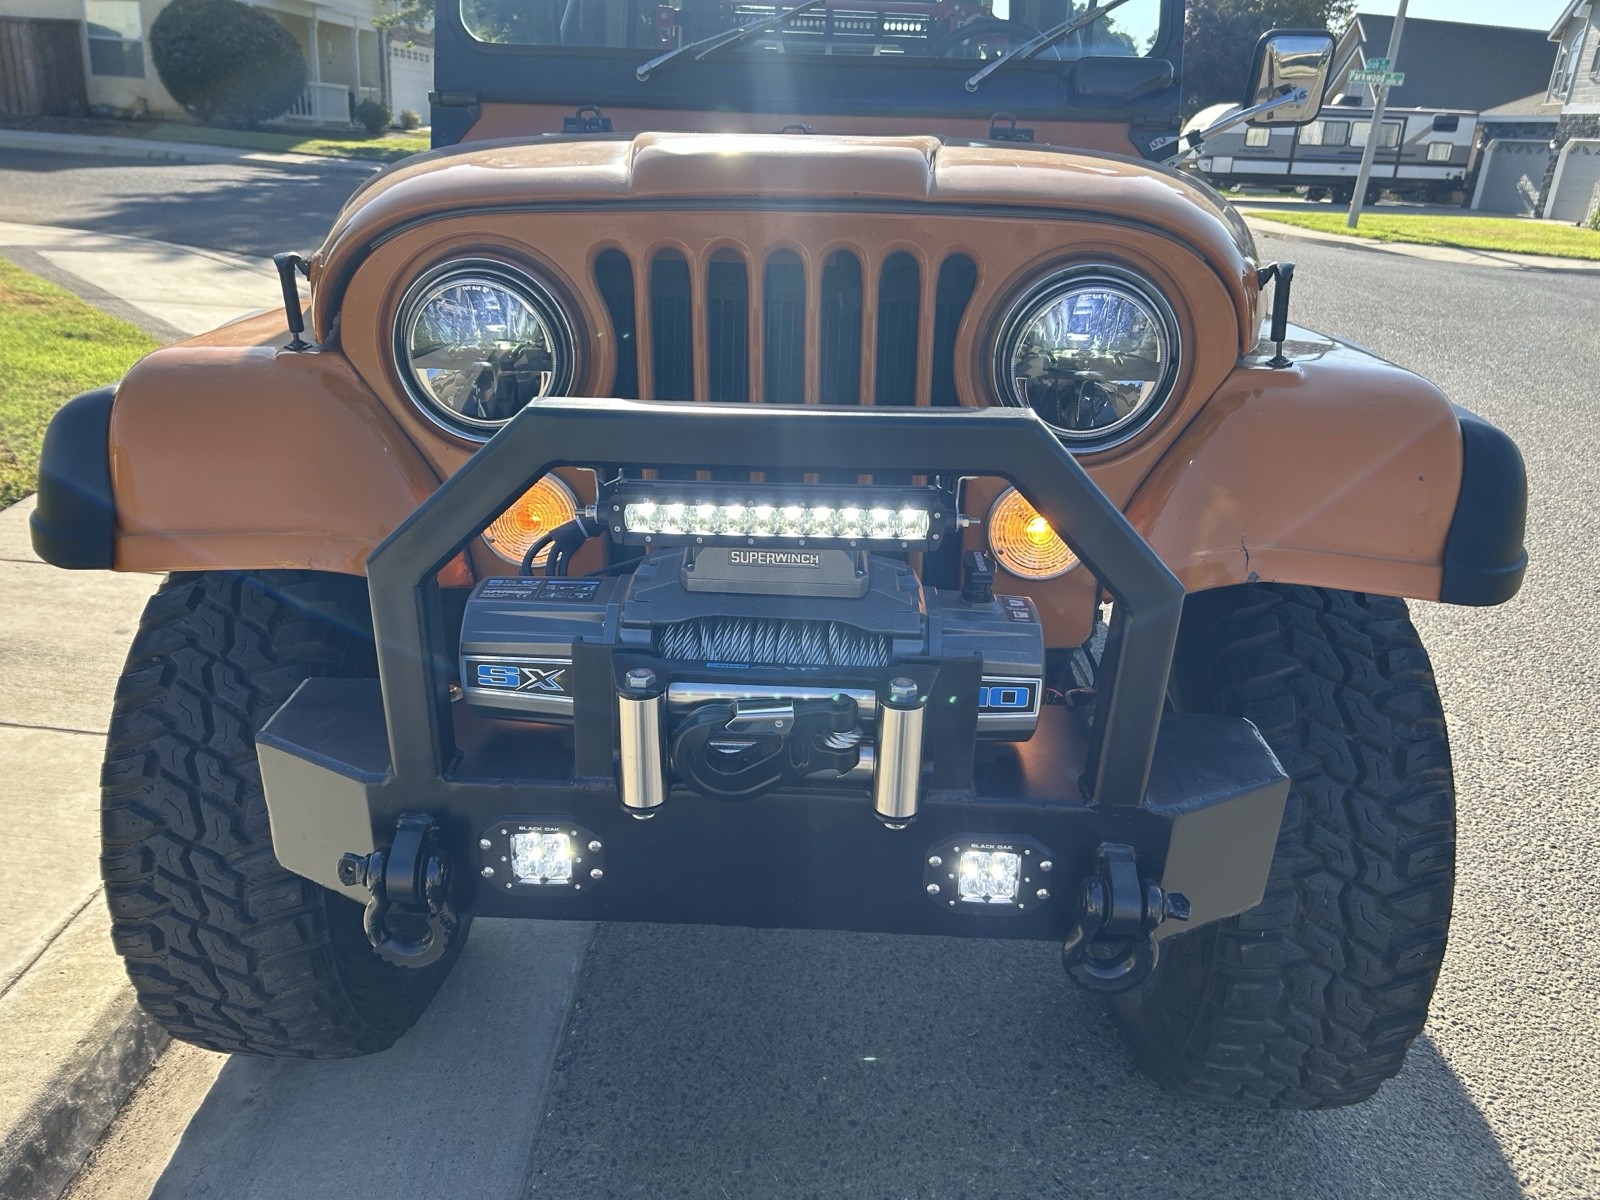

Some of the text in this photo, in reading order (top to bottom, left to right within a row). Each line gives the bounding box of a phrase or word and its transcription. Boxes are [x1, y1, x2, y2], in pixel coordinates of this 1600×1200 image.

[1349, 71, 1386, 83] Parkwood
[731, 551, 819, 565] SUPERWINCH
[478, 665, 566, 691] SX
